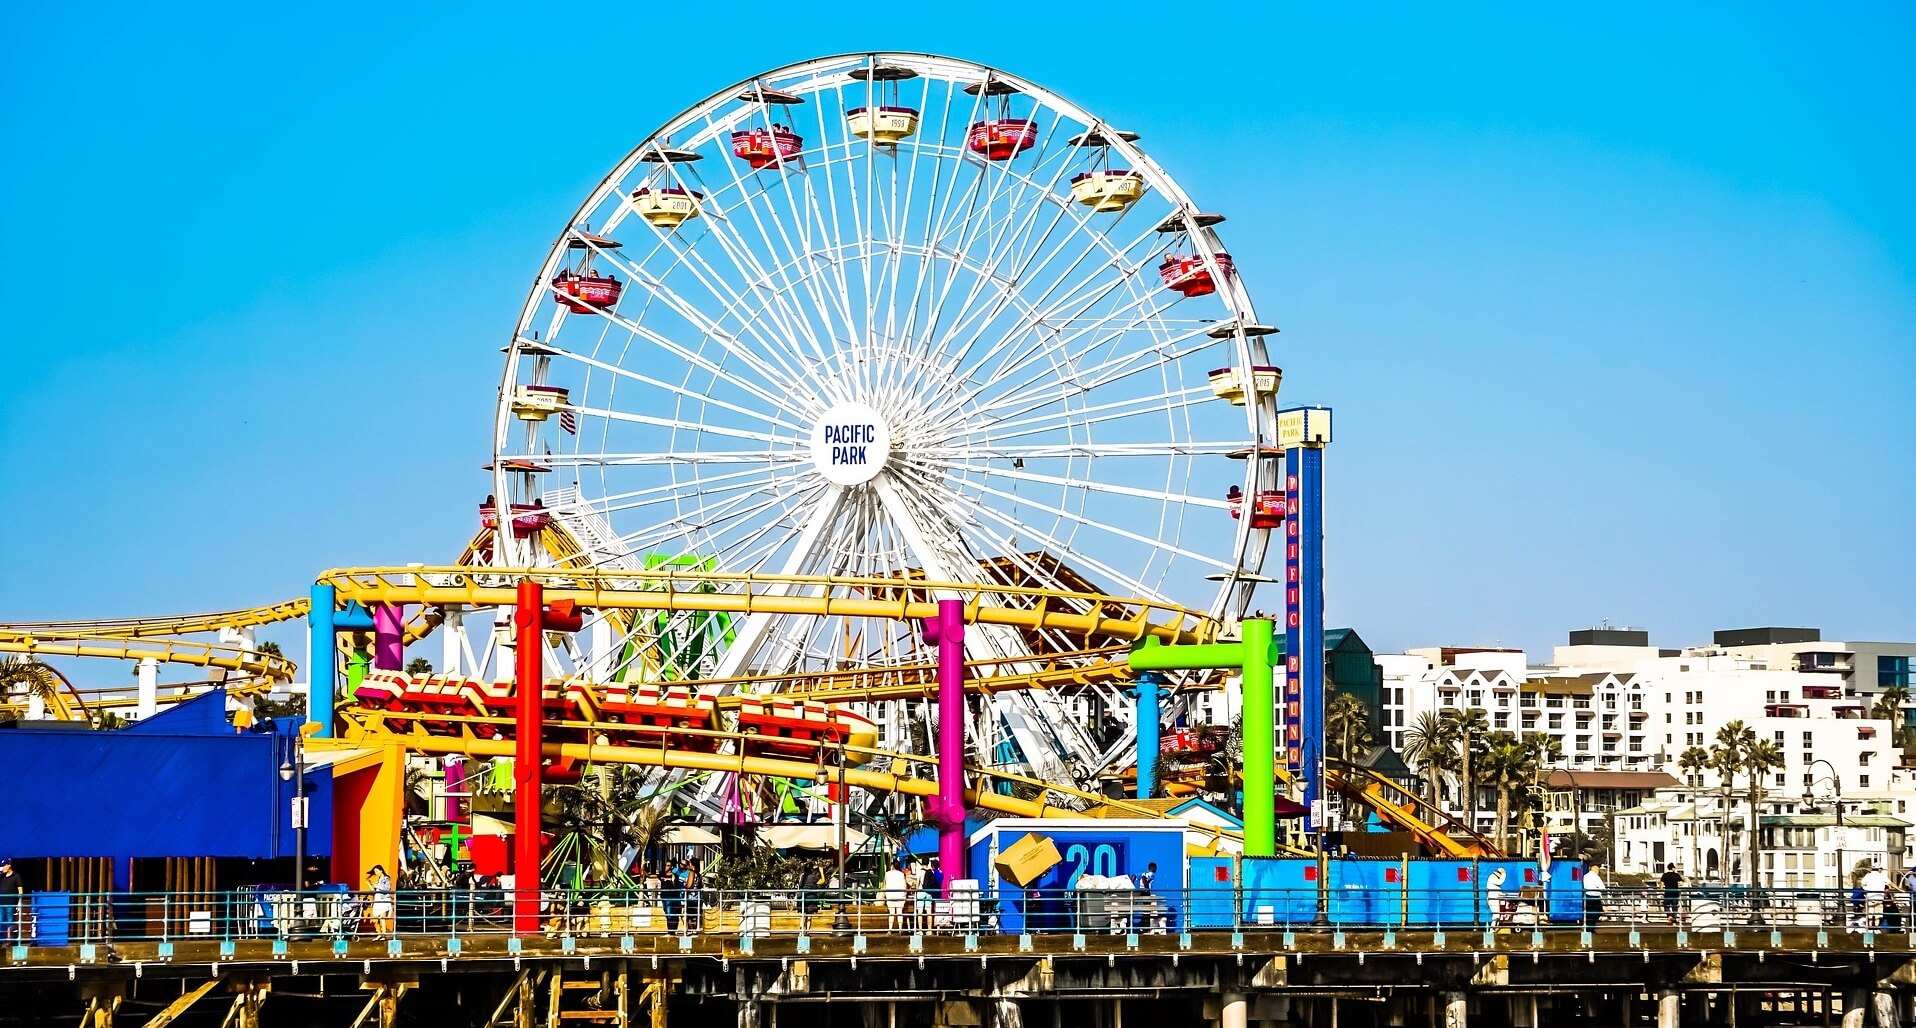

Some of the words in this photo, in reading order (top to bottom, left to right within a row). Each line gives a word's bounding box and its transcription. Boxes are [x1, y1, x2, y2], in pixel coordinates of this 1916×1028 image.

[1279, 417, 1303, 428] PACIFIC
[825, 424, 875, 444] PACIFIC
[1282, 429, 1300, 438] PARK
[832, 446, 867, 465] PARK
[1288, 476, 1298, 626] PACIFIC
[1066, 844, 1117, 890] 20
